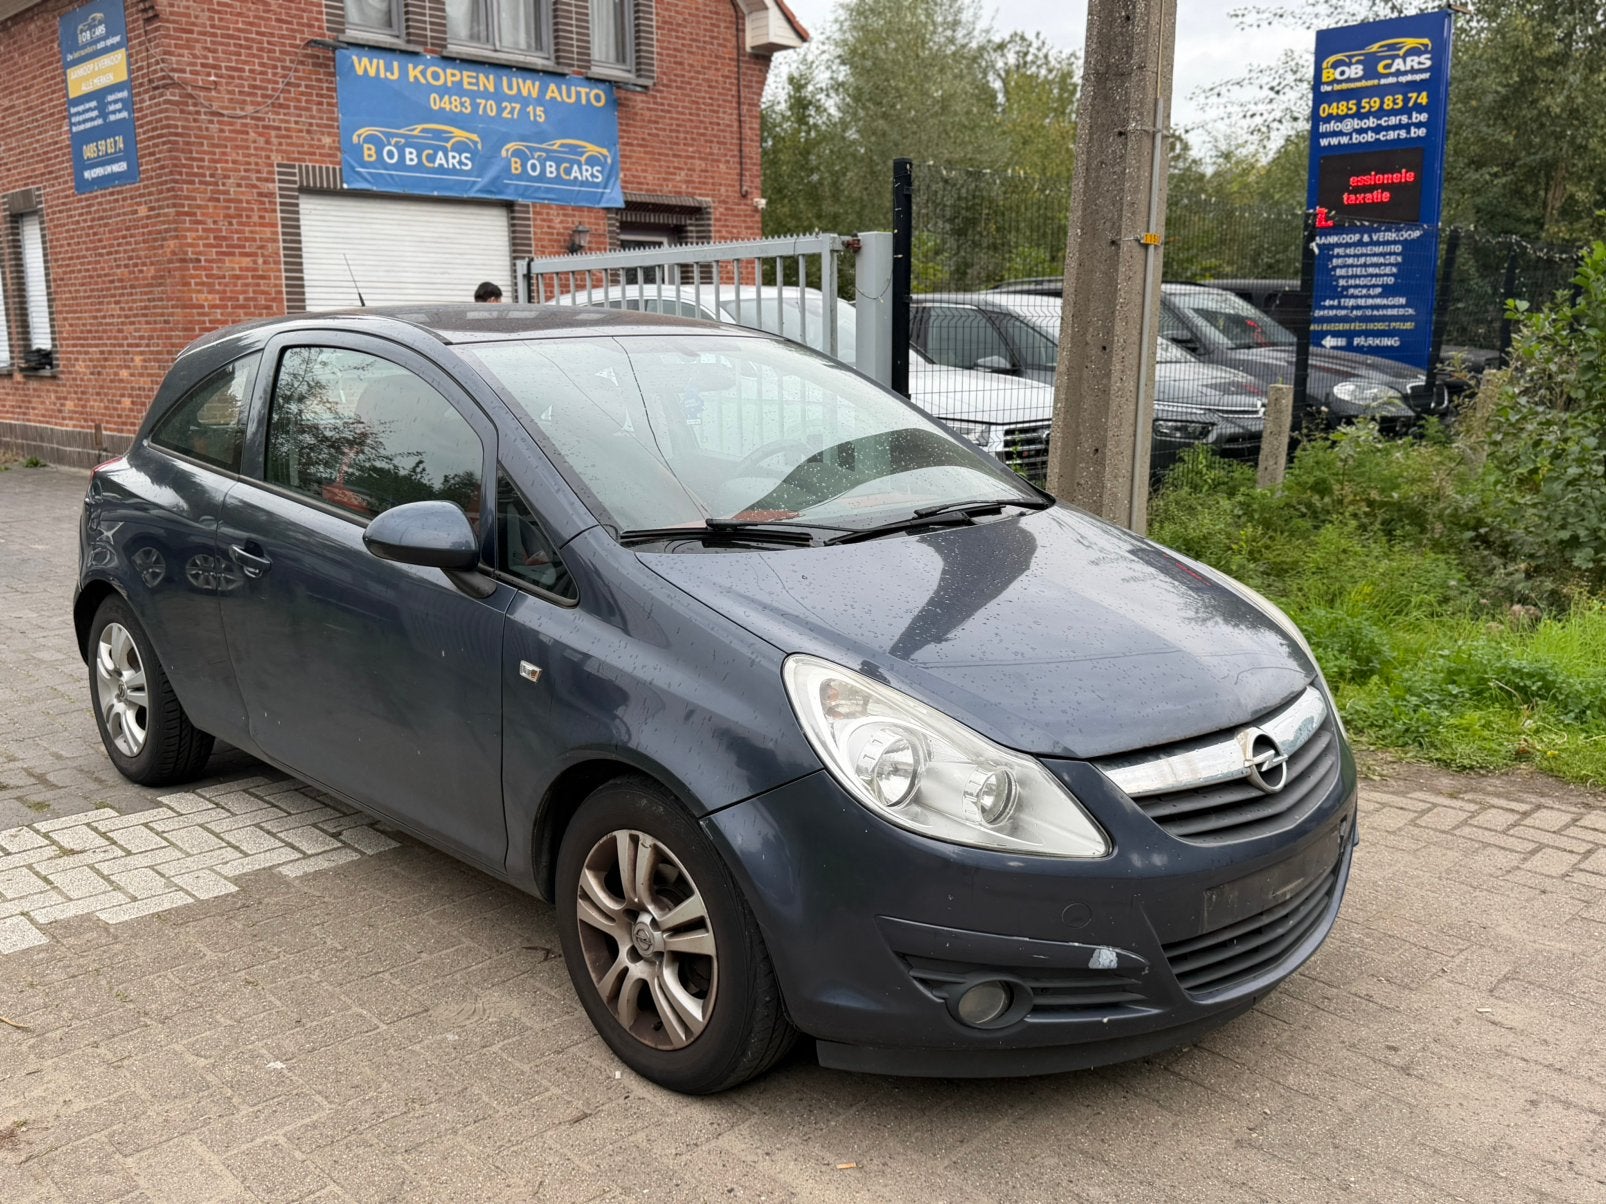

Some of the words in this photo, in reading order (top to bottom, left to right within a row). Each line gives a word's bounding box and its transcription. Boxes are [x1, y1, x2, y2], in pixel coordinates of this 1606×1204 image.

[1322, 64, 1364, 82] BOB
[1377, 54, 1432, 74] CARS
[352, 56, 400, 81] WIJ
[408, 63, 495, 93] KOPEN
[502, 76, 540, 98] UW
[545, 83, 606, 108] AUTO
[1320, 84, 1333, 92] Uw
[1333, 79, 1379, 91] betrouwbare
[1380, 76, 1397, 85] auto
[1398, 72, 1431, 83] opkoper
[429, 93, 472, 114] 0483
[476, 99, 498, 117] 70
[501, 102, 521, 119] 27
[526, 105, 545, 123] 15
[1319, 100, 1357, 117] 0485
[1360, 97, 1380, 113] 59
[1383, 94, 1404, 110] 83
[1407, 91, 1428, 107] 74
[1319, 111, 1428, 133] info@bob-cars.be
[98, 140, 105, 156] 59
[115, 135, 124, 152] 74
[1319, 126, 1427, 147] www.bob-cars.be
[422, 150, 473, 171] CARS
[560, 163, 602, 183] CARS
[1349, 168, 1415, 187] essionele
[1343, 189, 1391, 205] taxatie
[1315, 233, 1360, 245] AANKOOP
[1362, 234, 1370, 242] &
[1371, 230, 1420, 242] VERKOOP
[1335, 266, 1397, 276] BESTELWAGEN
[1338, 276, 1395, 286] SCHADEAUTO
[1347, 287, 1382, 296] PICK-UP
[1353, 336, 1400, 346] PARKING
